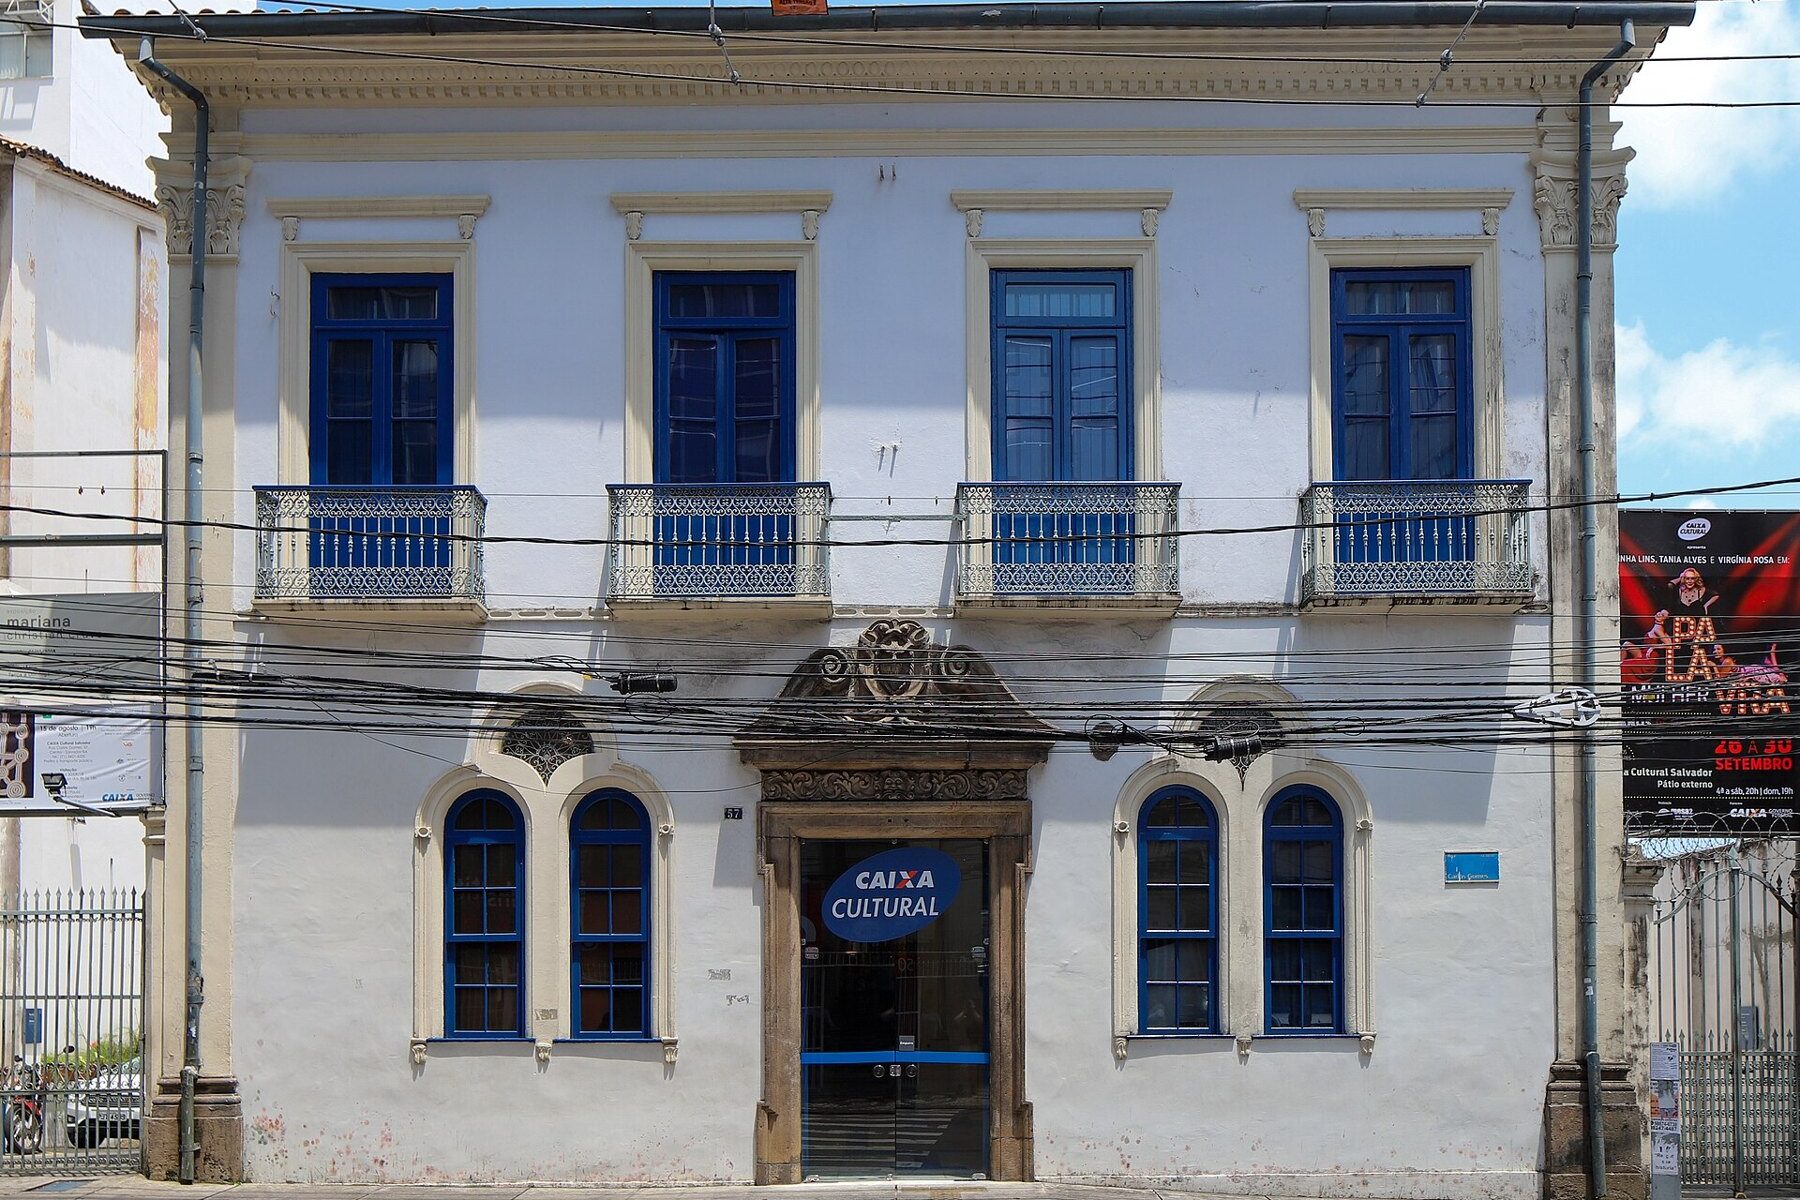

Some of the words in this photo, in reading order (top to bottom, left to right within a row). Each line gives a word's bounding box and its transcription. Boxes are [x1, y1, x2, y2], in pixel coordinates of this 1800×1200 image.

[1638, 556, 1658, 564] LINS,
[1718, 554, 1752, 564] VIRGÍNIA
[7, 615, 70, 628] mariana
[1748, 740, 1758, 754] A
[1716, 758, 1792, 770] SETEMBRO
[1631, 768, 1669, 777] Cultural
[1670, 768, 1712, 777] Salvador
[1658, 780, 1679, 788] Pátio
[1731, 787, 1744, 795] sáb,
[727, 809, 739, 819] 57
[1729, 808, 1767, 817] CAIXA
[856, 870, 934, 890] CAIXA
[832, 896, 939, 918] CULTURAL
